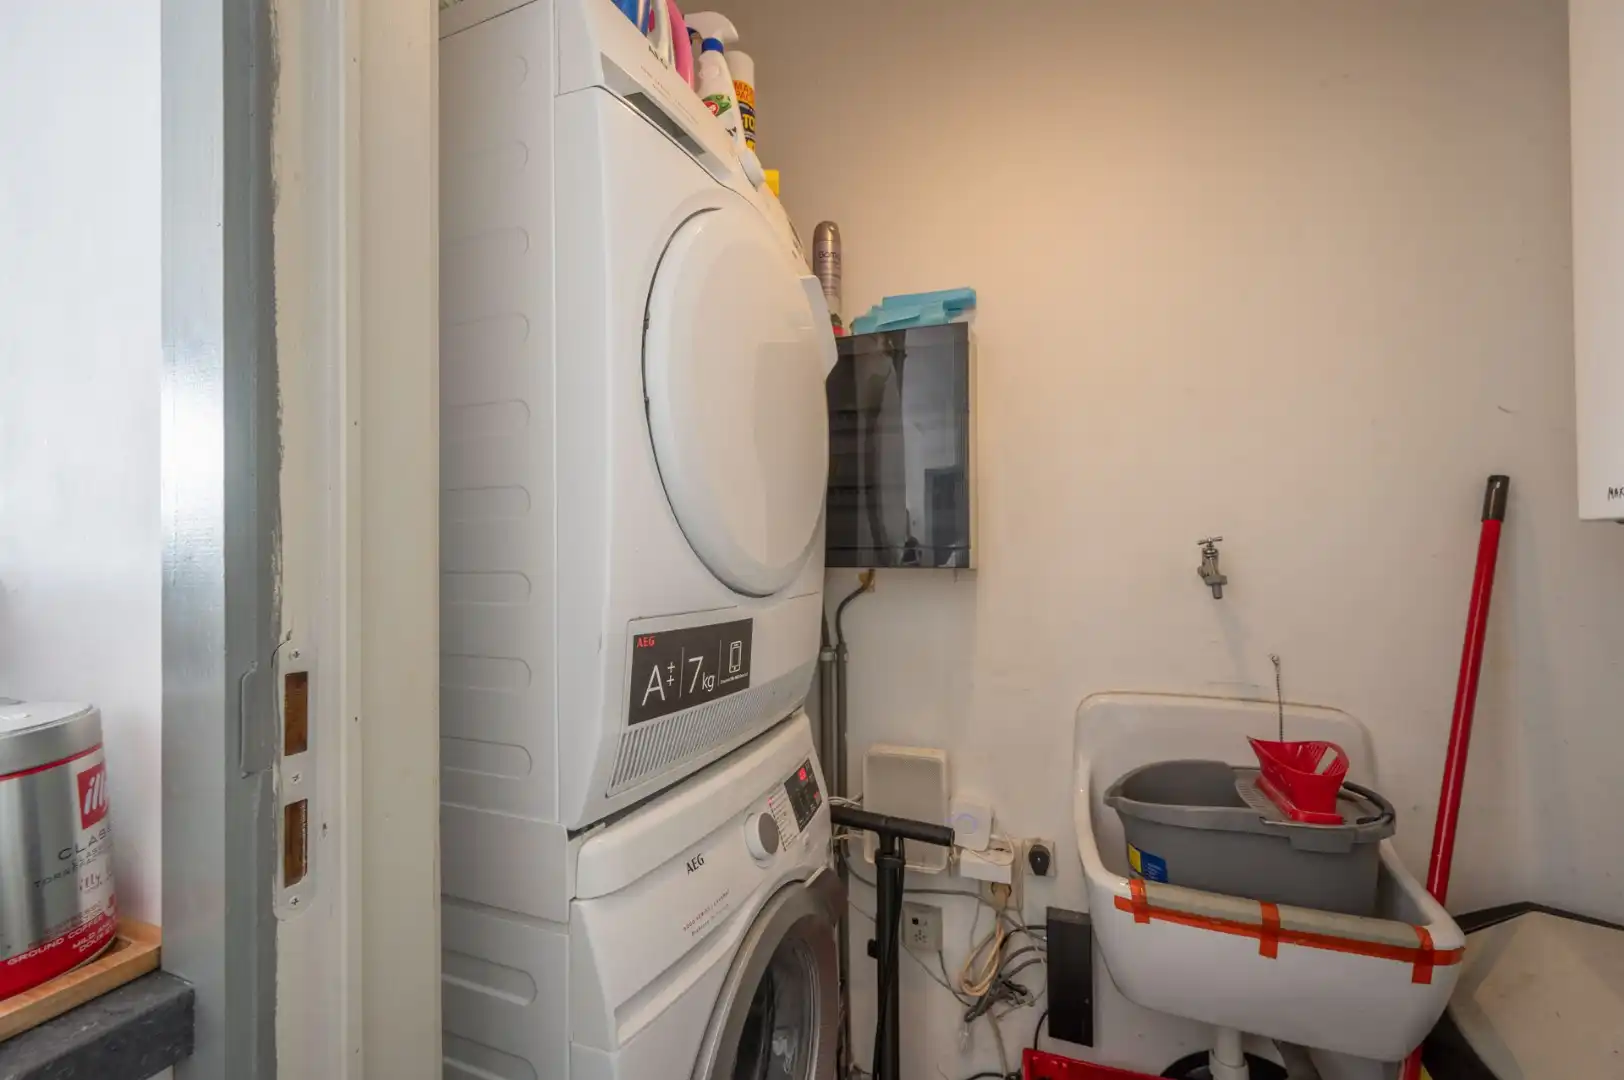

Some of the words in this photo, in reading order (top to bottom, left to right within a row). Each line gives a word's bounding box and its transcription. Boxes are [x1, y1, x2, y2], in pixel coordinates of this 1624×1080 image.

[637, 636, 656, 648] AEG
[641, 661, 676, 706] A++
[686, 853, 705, 874] AEG
[7, 937, 65, 966] GROUND
